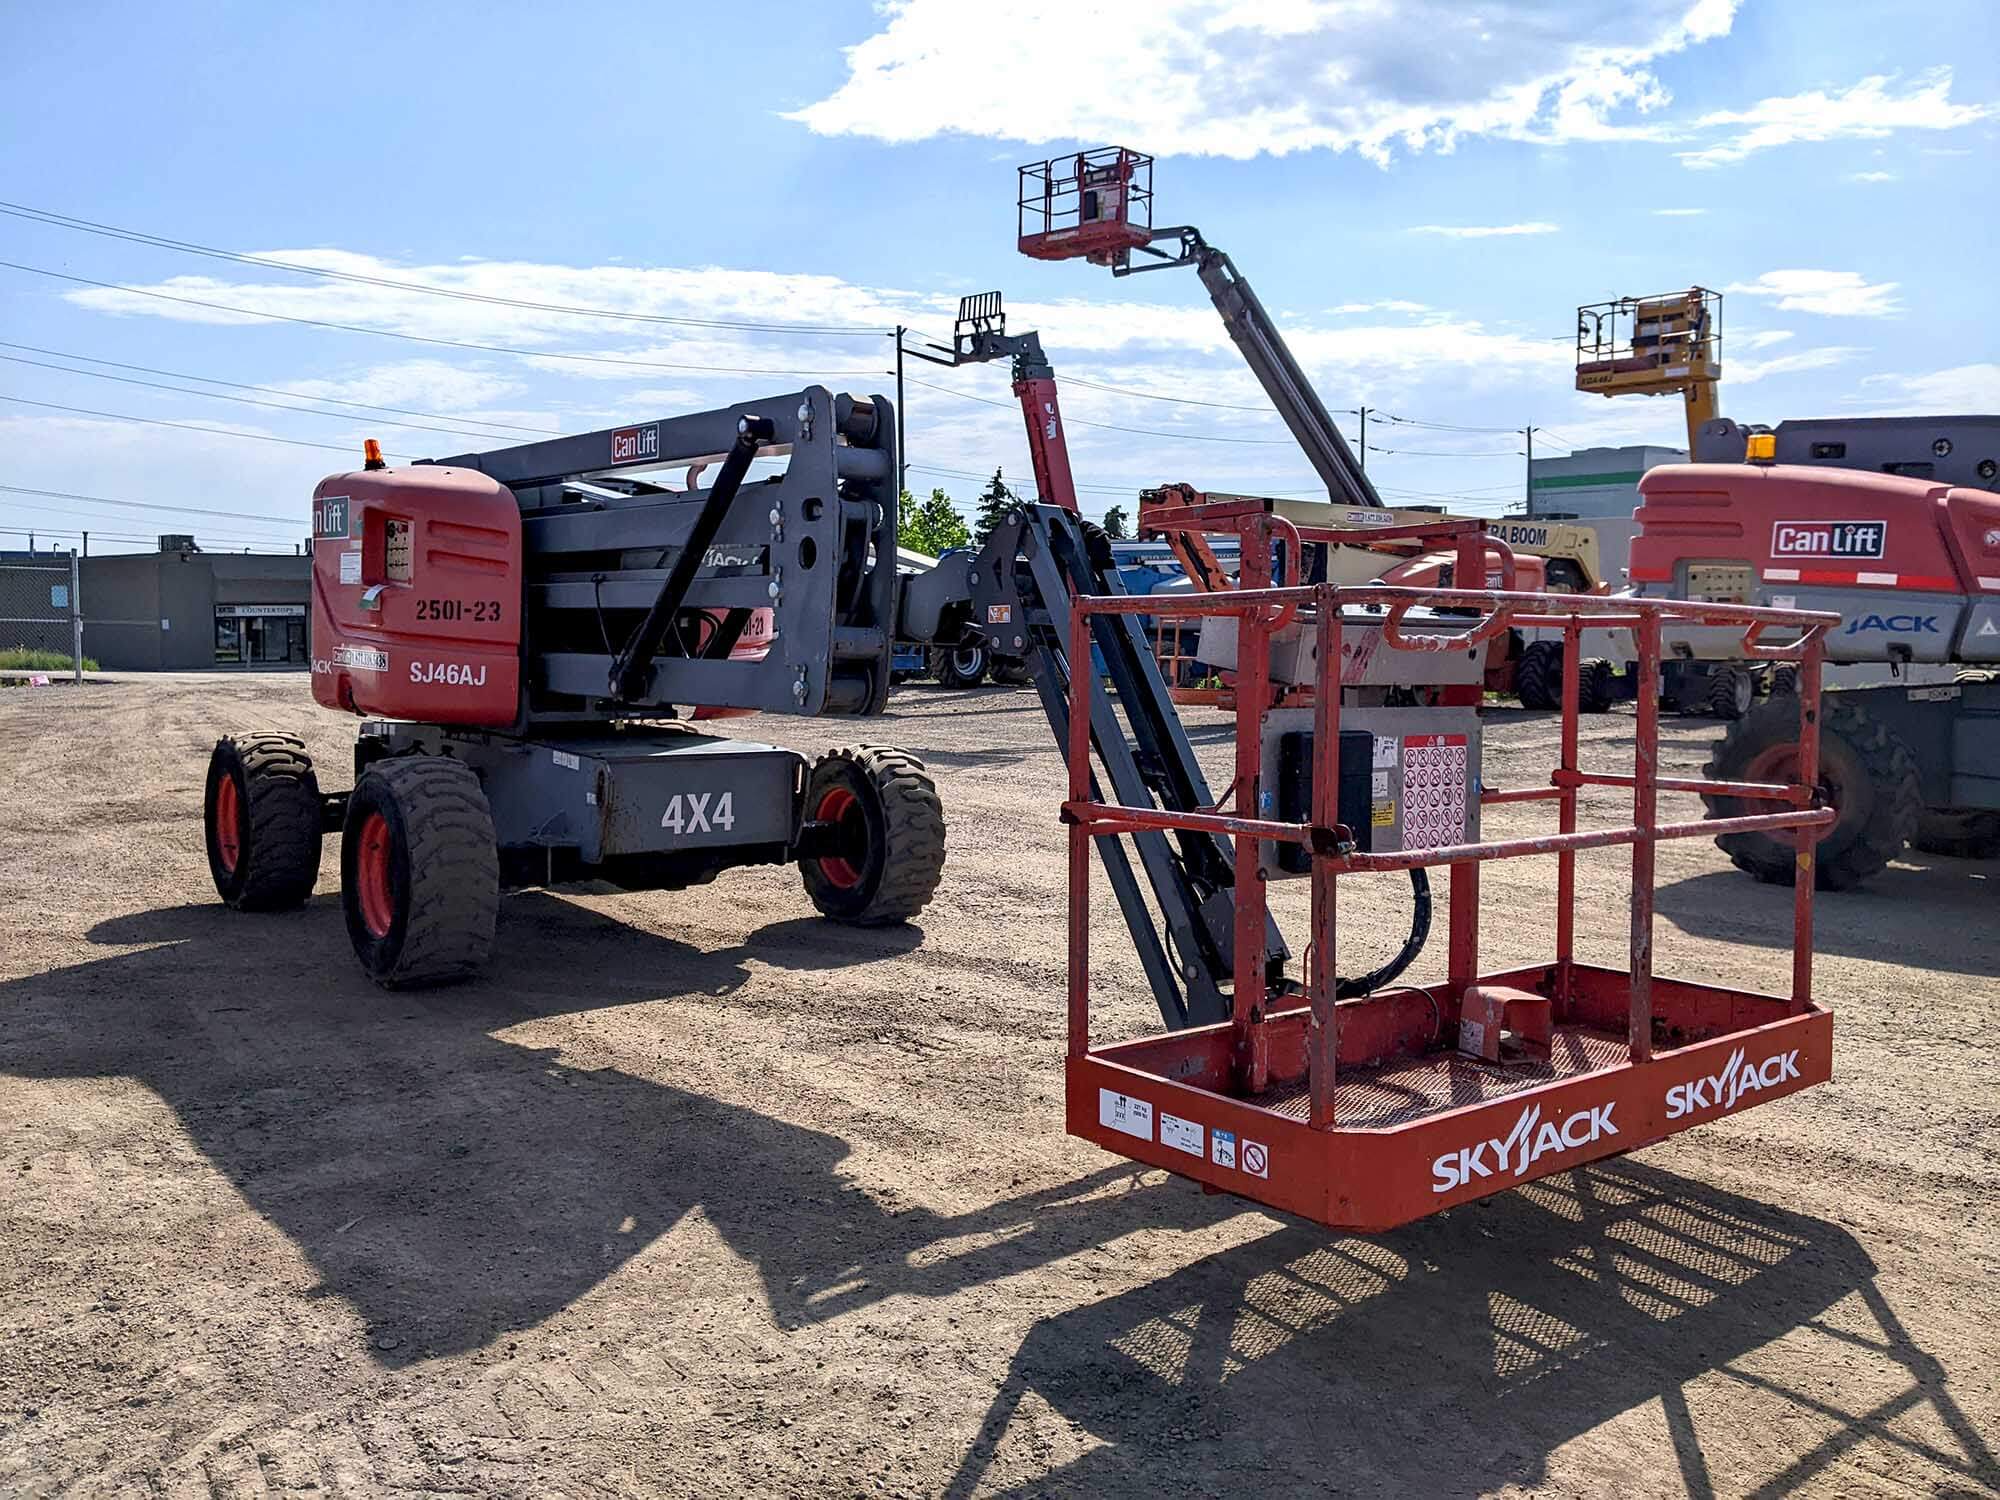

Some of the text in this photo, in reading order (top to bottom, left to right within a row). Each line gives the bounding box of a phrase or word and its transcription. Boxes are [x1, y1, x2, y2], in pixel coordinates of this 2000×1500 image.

[615, 429, 656, 457] CanLift
[1488, 525, 1547, 546] RA BOOM
[1779, 525, 1877, 552] CanLift
[416, 600, 501, 622] 2501-23
[311, 660, 332, 675] ACK
[410, 661, 486, 686] SJ46AJ
[661, 792, 735, 835] 4X4
[1665, 1048, 1801, 1119] SKYJACK
[1432, 1102, 1619, 1193] SKYJACK
